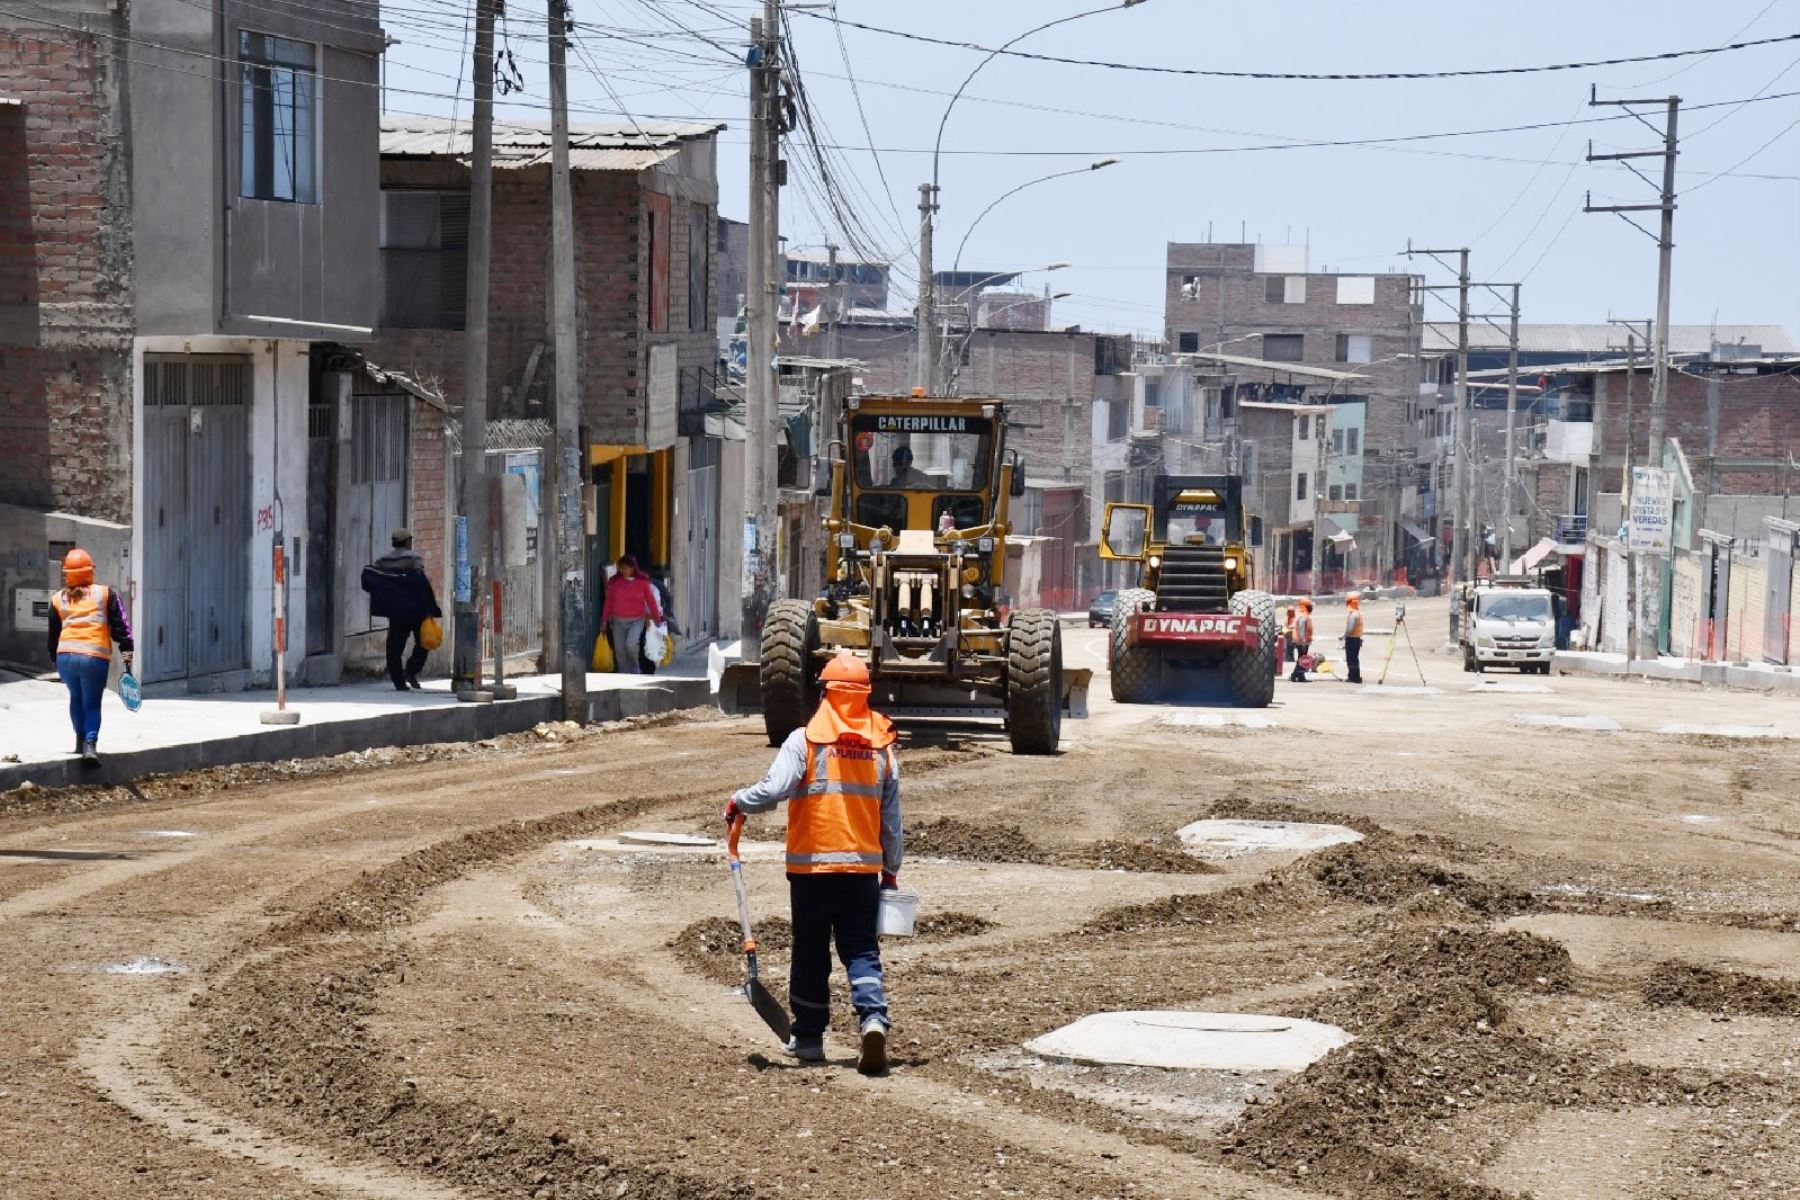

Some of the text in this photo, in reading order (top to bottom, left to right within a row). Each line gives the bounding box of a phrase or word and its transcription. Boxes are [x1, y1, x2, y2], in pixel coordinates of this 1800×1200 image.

[878, 416, 966, 431] CATERPILLAR
[1175, 503, 1217, 511] DYNAPAC
[1633, 515, 1668, 526] VEREDAS
[1143, 618, 1242, 633] DYNAPAC
